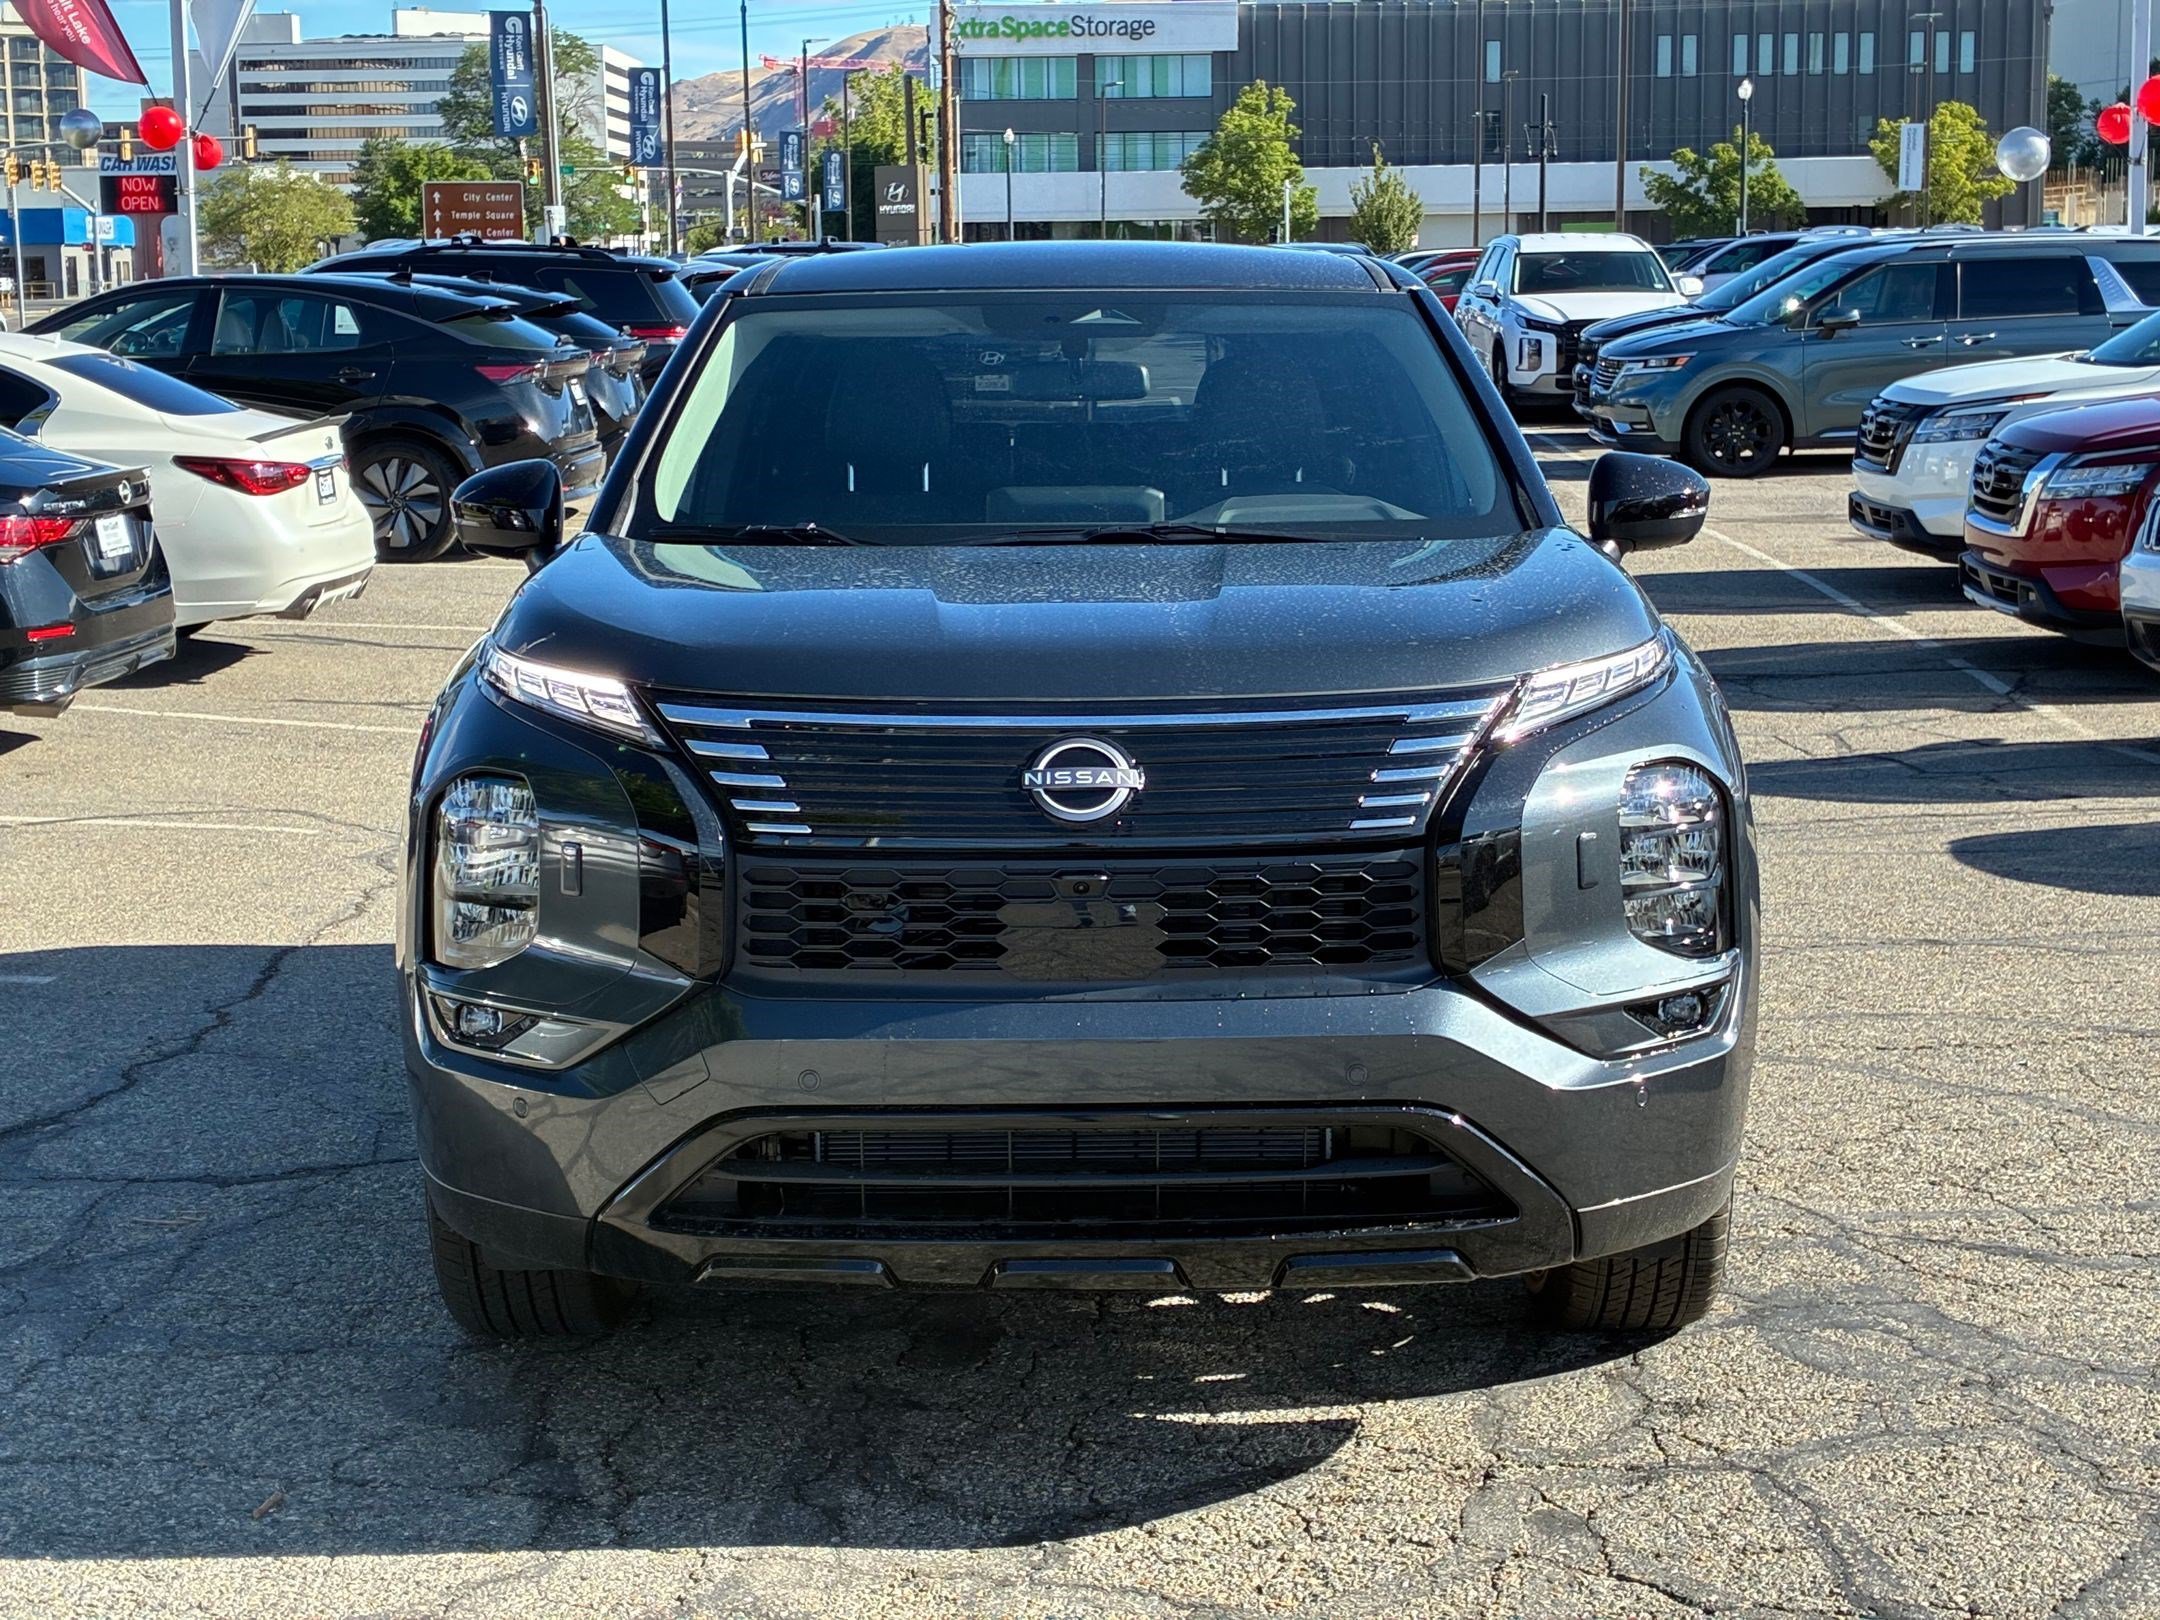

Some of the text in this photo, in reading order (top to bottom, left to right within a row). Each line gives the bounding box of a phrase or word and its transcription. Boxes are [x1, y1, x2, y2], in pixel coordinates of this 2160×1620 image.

[50, 3, 67, 25] hear
[61, 24, 76, 43] you
[68, 11, 91, 44] Lake
[504, 34, 517, 80] Hyundai
[501, 92, 511, 132] HYUNDAI
[121, 177, 156, 192] NOW
[121, 196, 159, 210] OPEN
[463, 193, 514, 202] City Center
[451, 210, 515, 220] Temple Square
[879, 204, 915, 214] HYUNDAI
[486, 227, 514, 237] Center
[1024, 770, 1134, 786] NISSAN
